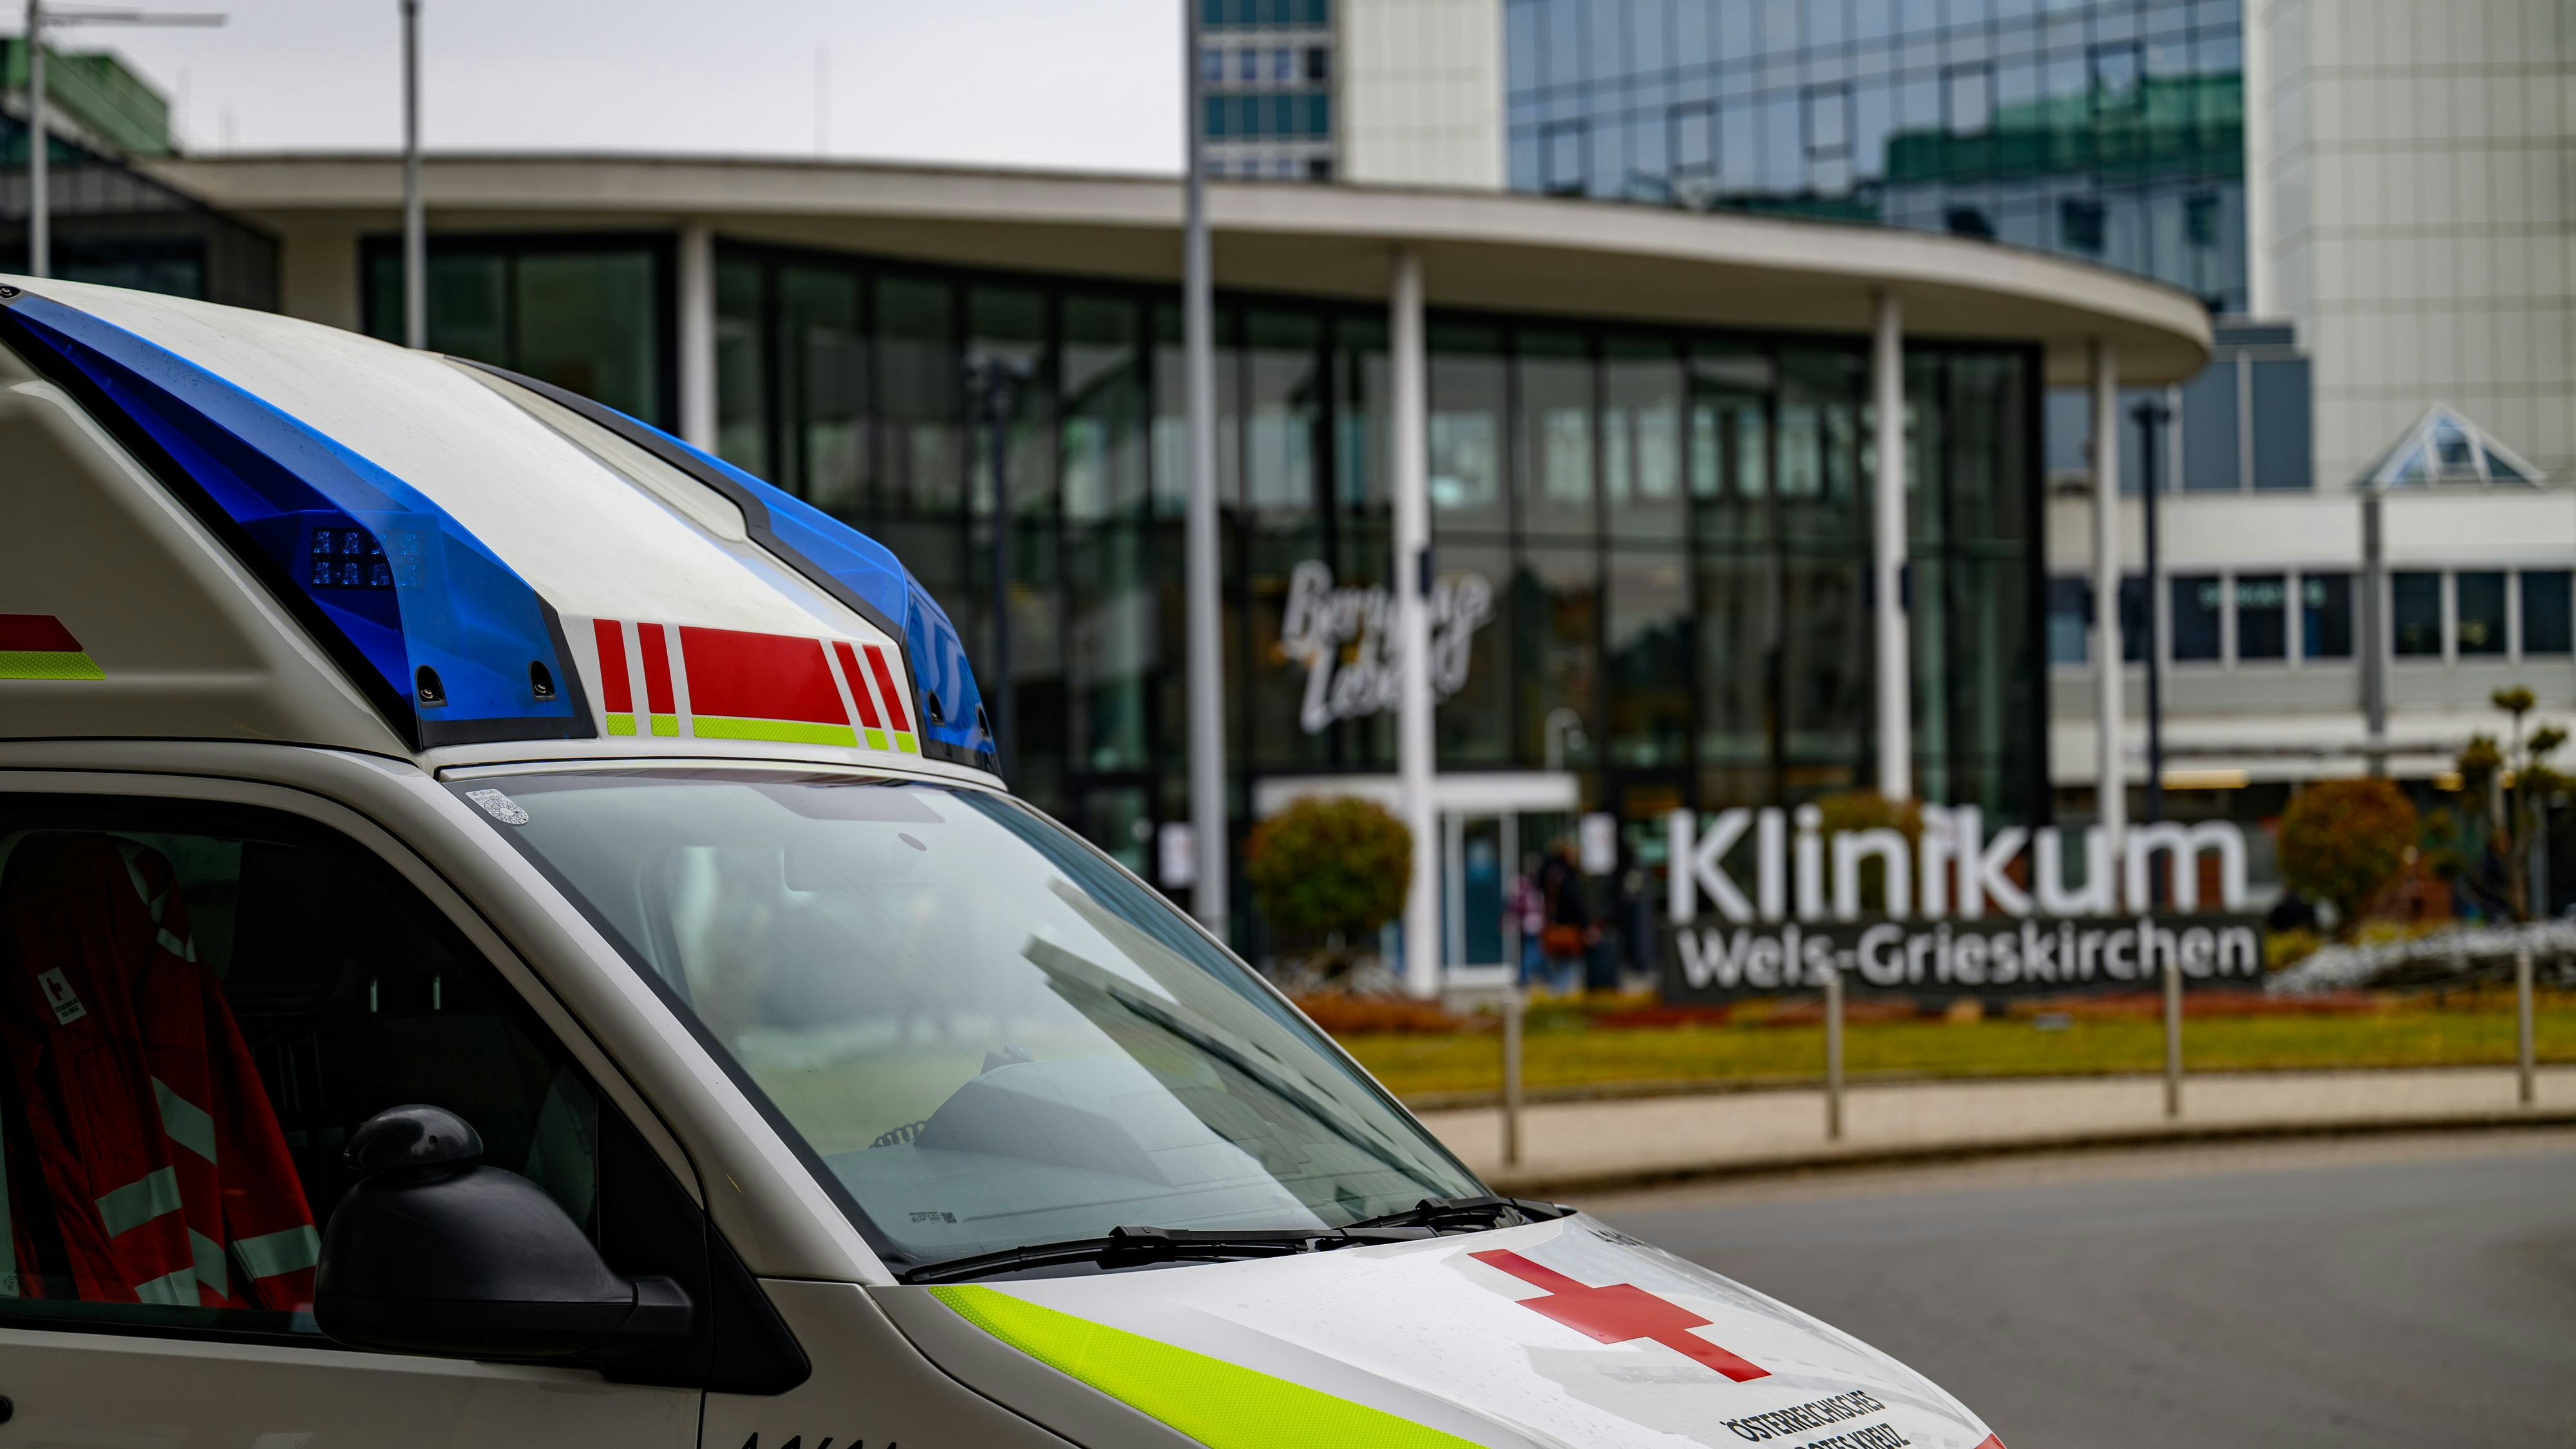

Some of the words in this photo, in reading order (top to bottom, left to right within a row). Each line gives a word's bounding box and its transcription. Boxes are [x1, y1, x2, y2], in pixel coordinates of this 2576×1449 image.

[1667, 804, 2248, 923] Klinikum
[1678, 916, 2258, 990] Wels-Grieskirchen
[1719, 1390, 1886, 1443] ÖSTERREICHISCHES
[1846, 1423, 1911, 1449] KREUZ
